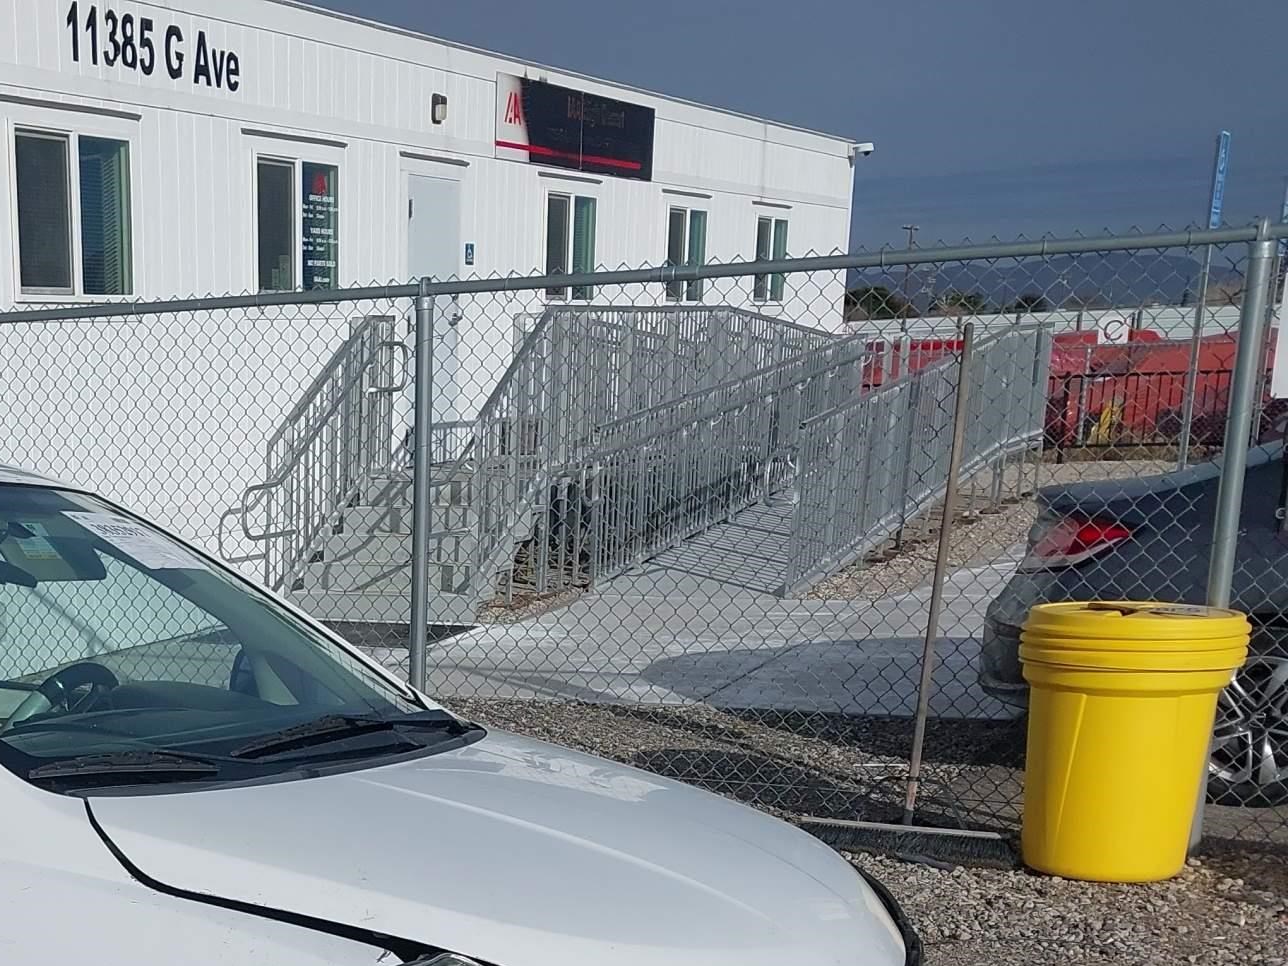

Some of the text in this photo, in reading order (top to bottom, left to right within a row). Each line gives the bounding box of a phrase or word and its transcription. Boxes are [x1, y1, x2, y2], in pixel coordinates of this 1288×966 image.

[66, 1, 241, 92] 11385 G Ave
